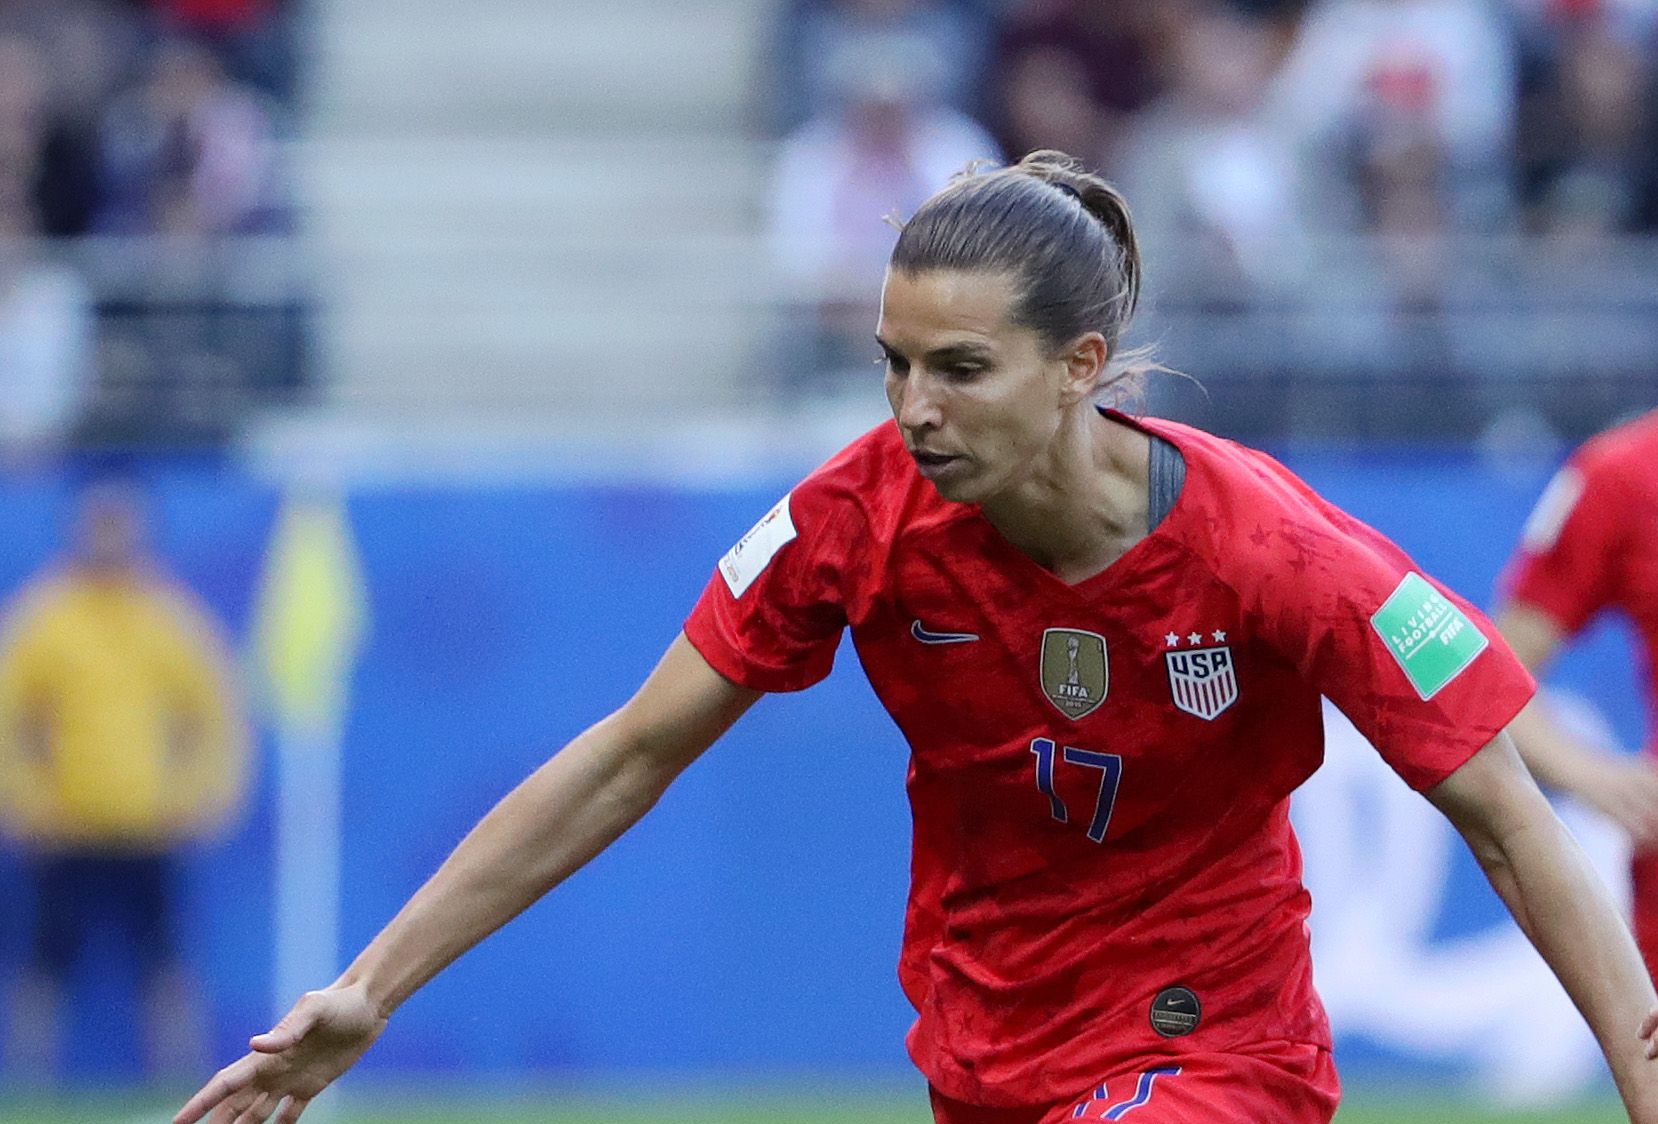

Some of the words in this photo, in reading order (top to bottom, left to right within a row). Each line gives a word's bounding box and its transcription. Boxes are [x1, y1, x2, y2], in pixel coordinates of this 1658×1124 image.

[1391, 592, 1440, 645] LIVING
[1398, 602, 1448, 654] FOOTBALL
[1439, 616, 1465, 646] FIFA
[1171, 650, 1228, 679] USA
[1058, 684, 1088, 699] FIFA
[1030, 737, 1122, 843] 17
